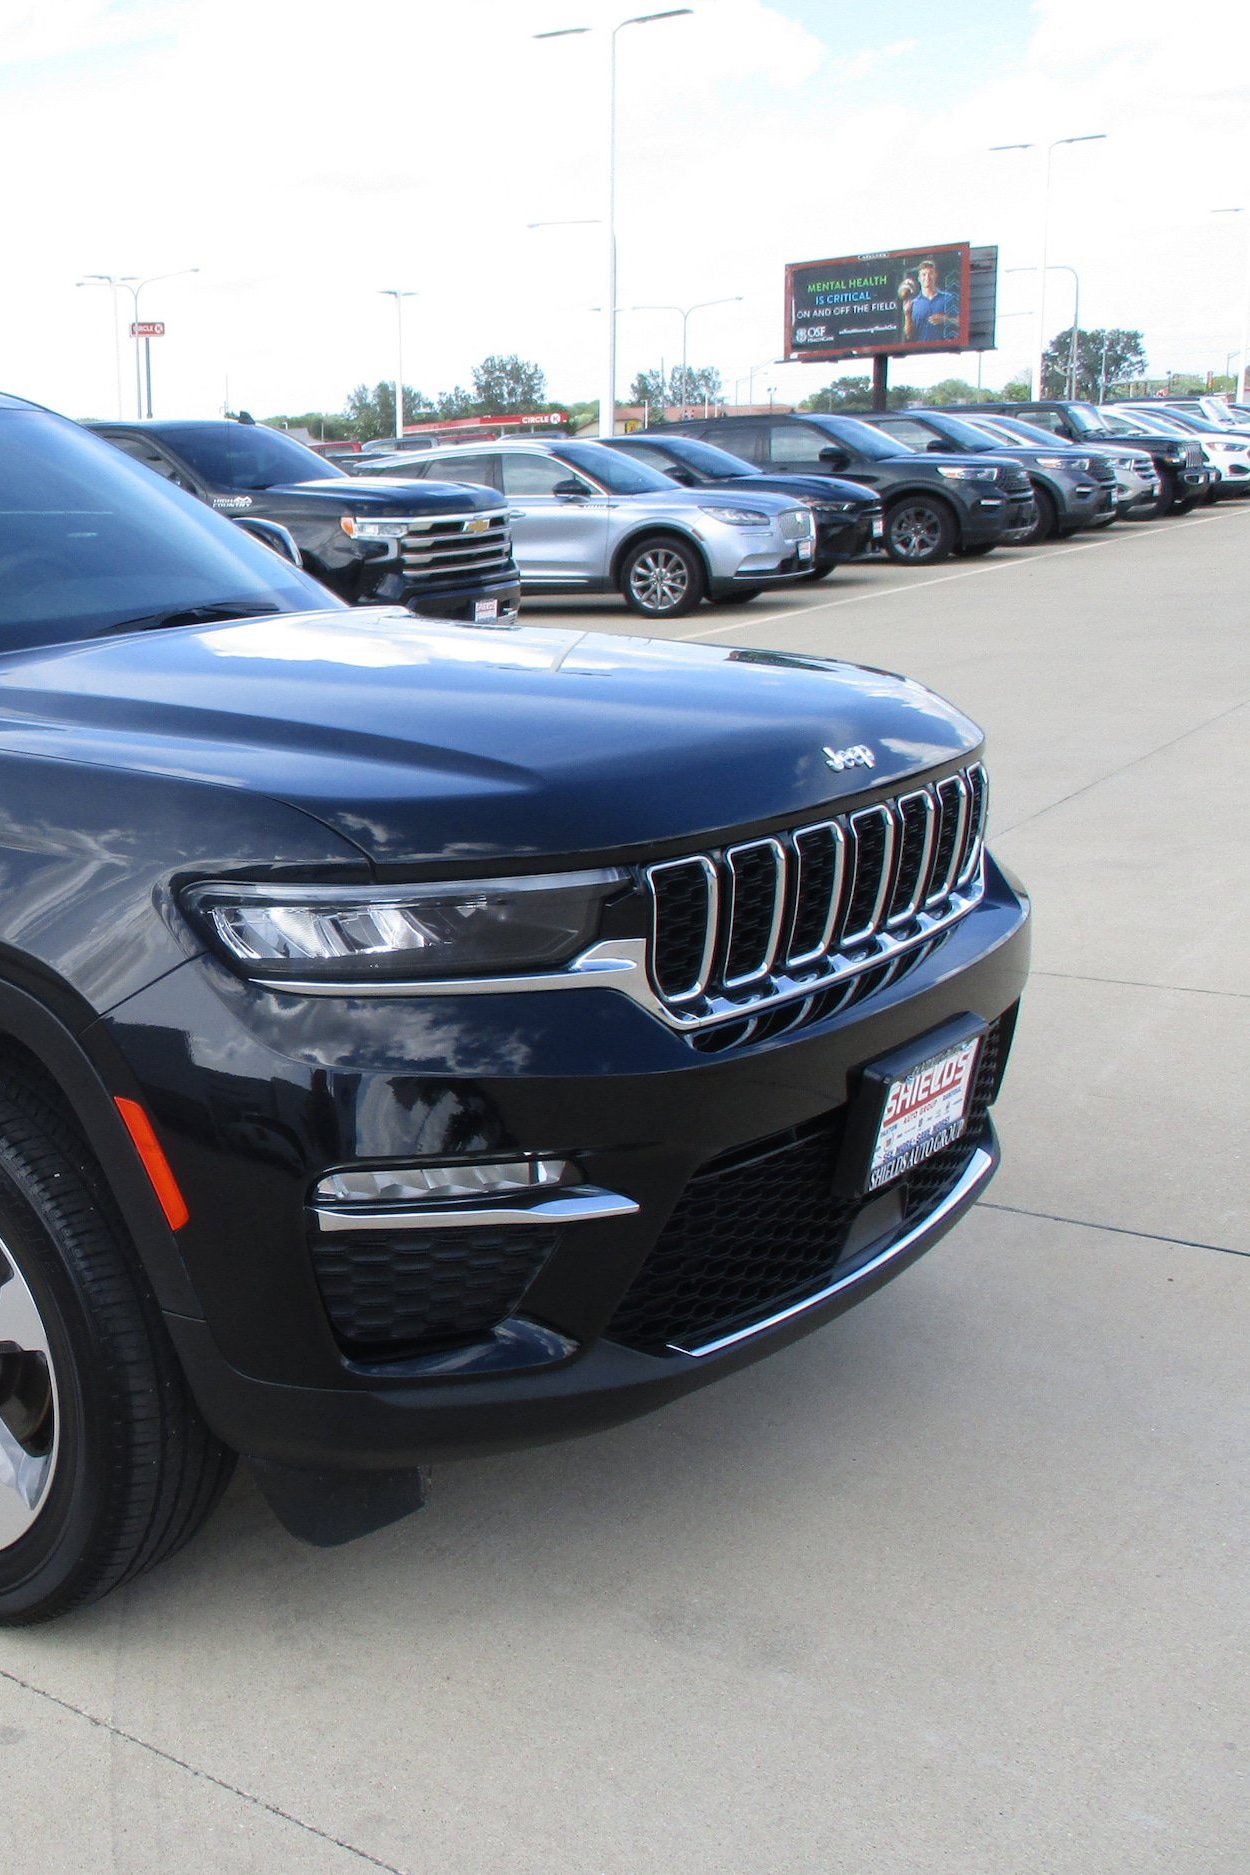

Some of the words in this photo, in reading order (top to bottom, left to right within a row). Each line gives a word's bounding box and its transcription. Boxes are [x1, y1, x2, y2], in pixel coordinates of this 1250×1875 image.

[807, 280, 846, 293] MENTAL
[848, 275, 888, 288] HEALTH
[815, 296, 825, 305] IS
[826, 291, 872, 304] CRITICAL
[796, 310, 810, 319] ON
[812, 308, 831, 318] AND
[833, 305, 850, 316] OFF
[853, 303, 869, 314] THE
[807, 326, 826, 338] OSF
[522, 416, 549, 424] CIRCLE
[822, 744, 875, 773] Jeep
[884, 1051, 971, 1118] SHIELDS
[869, 1152, 908, 1192] SHIELDS
[906, 1138, 935, 1169] AUTO
[933, 1119, 965, 1153] GROUP
